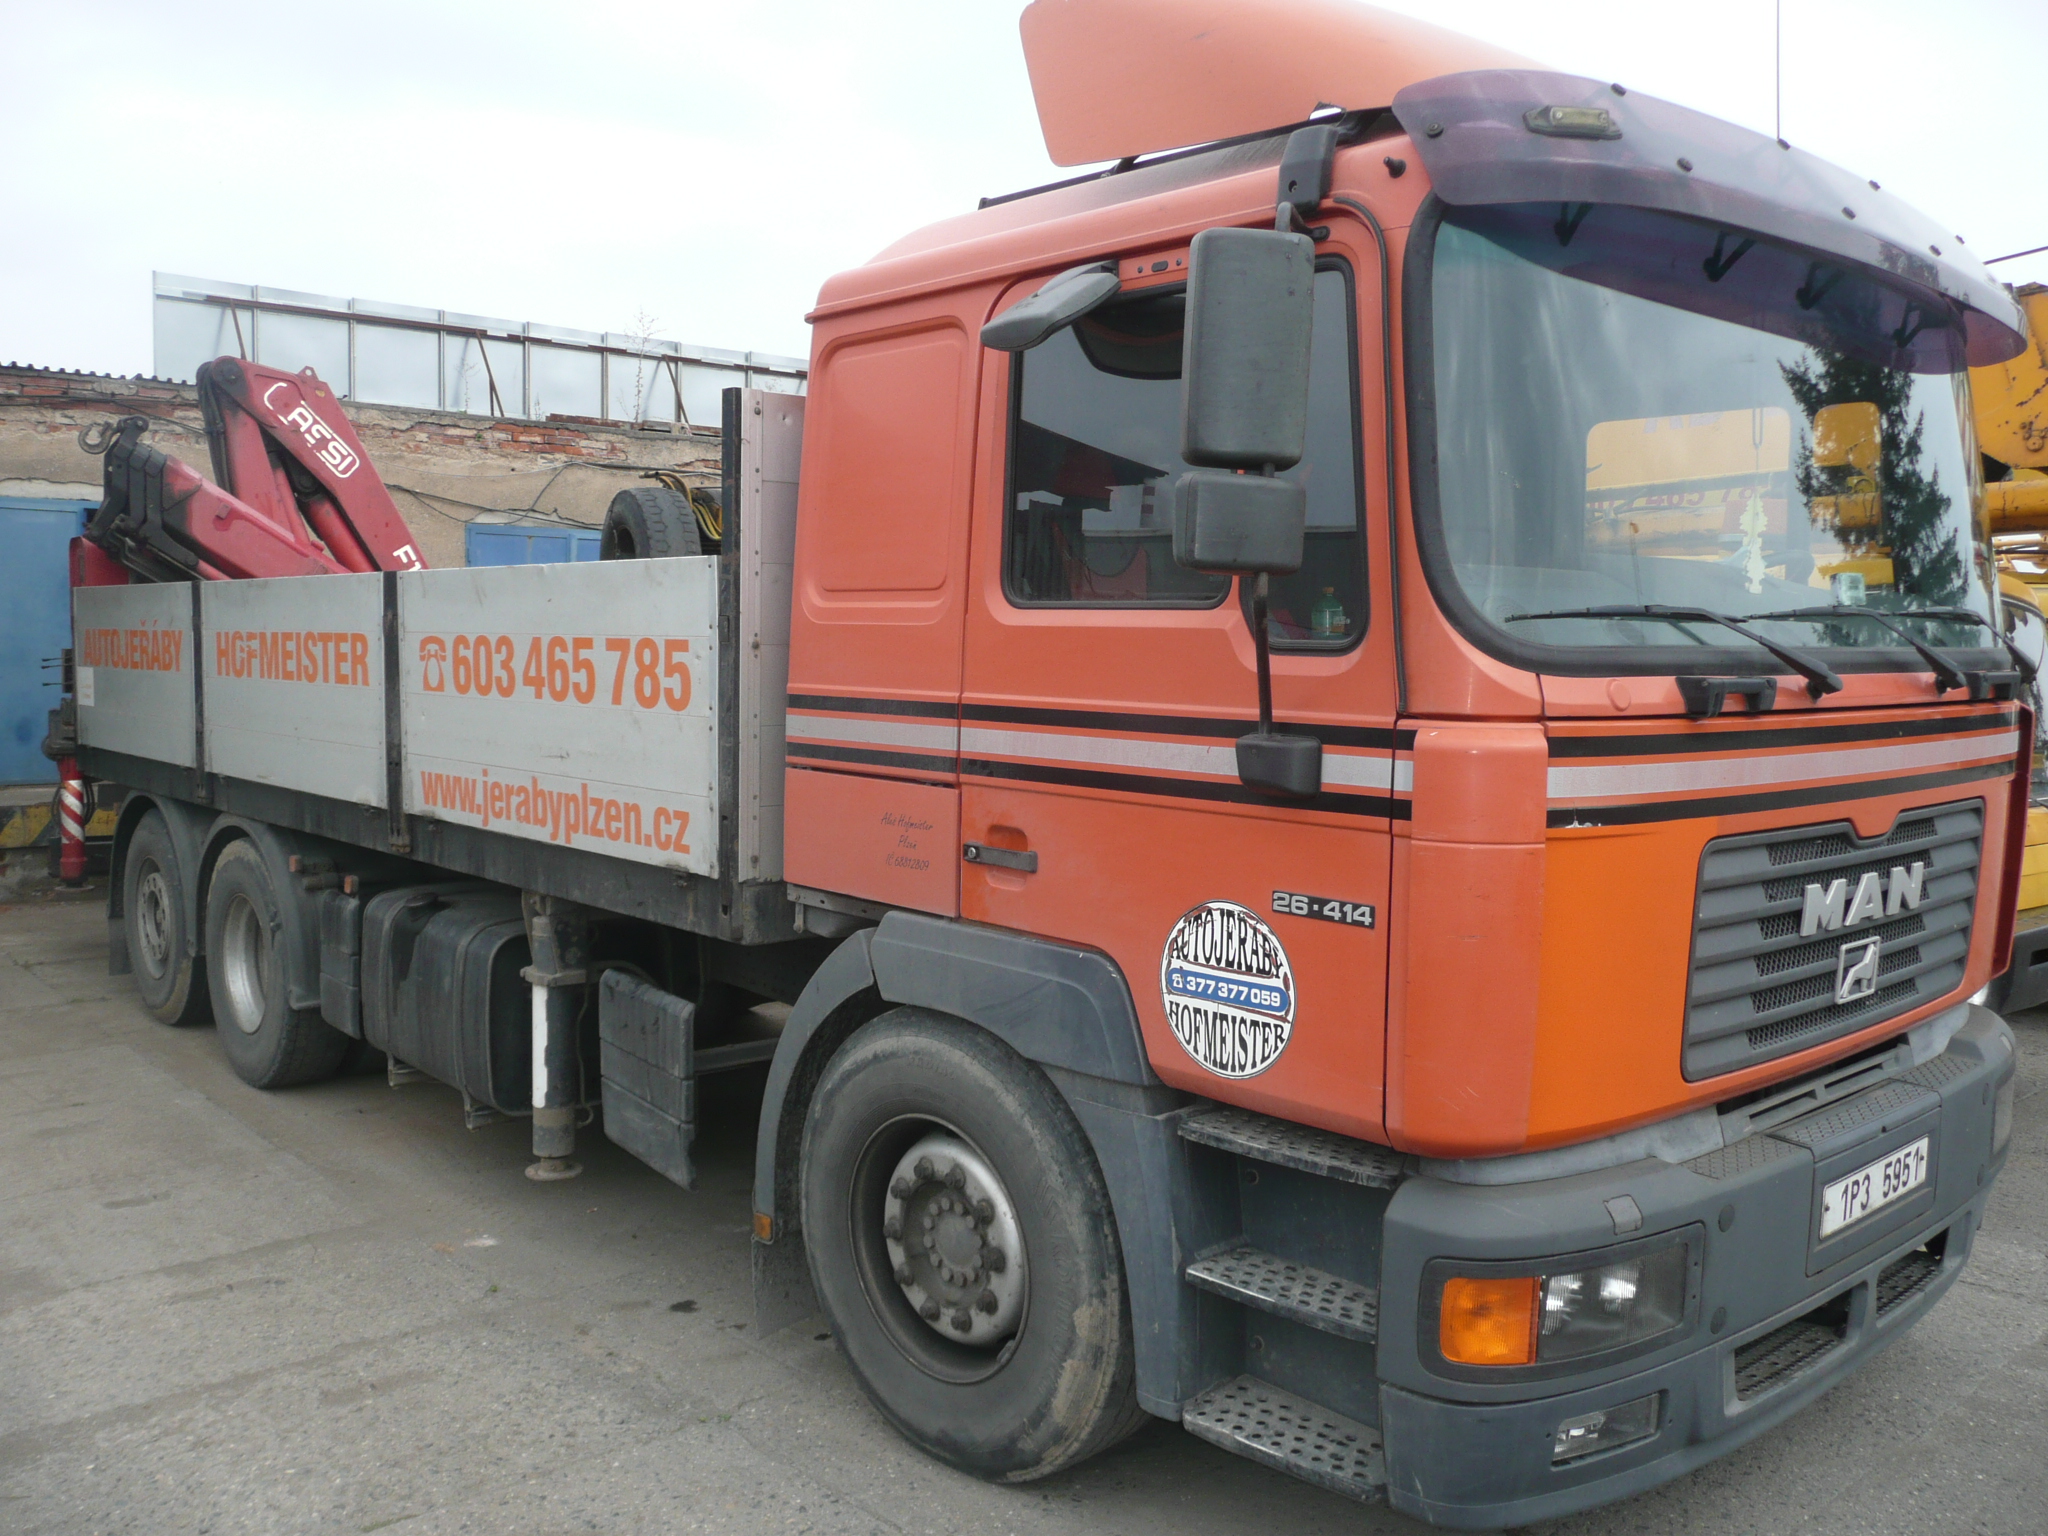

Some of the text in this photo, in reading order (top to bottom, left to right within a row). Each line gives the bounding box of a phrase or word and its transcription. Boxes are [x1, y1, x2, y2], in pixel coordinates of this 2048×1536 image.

[83, 620, 183, 672] AUTOJEŘÁBY
[216, 630, 370, 687] HOFMEISTER
[452, 634, 692, 712] 603 465 785
[420, 768, 691, 855] www.jerabyplzen.cz
[1800, 861, 1924, 937] MAN
[1186, 976, 1282, 1007] 377 377 059
[1169, 1000, 1286, 1073] HOFMEISTER
[1841, 1146, 1920, 1221] 1P3 5951
